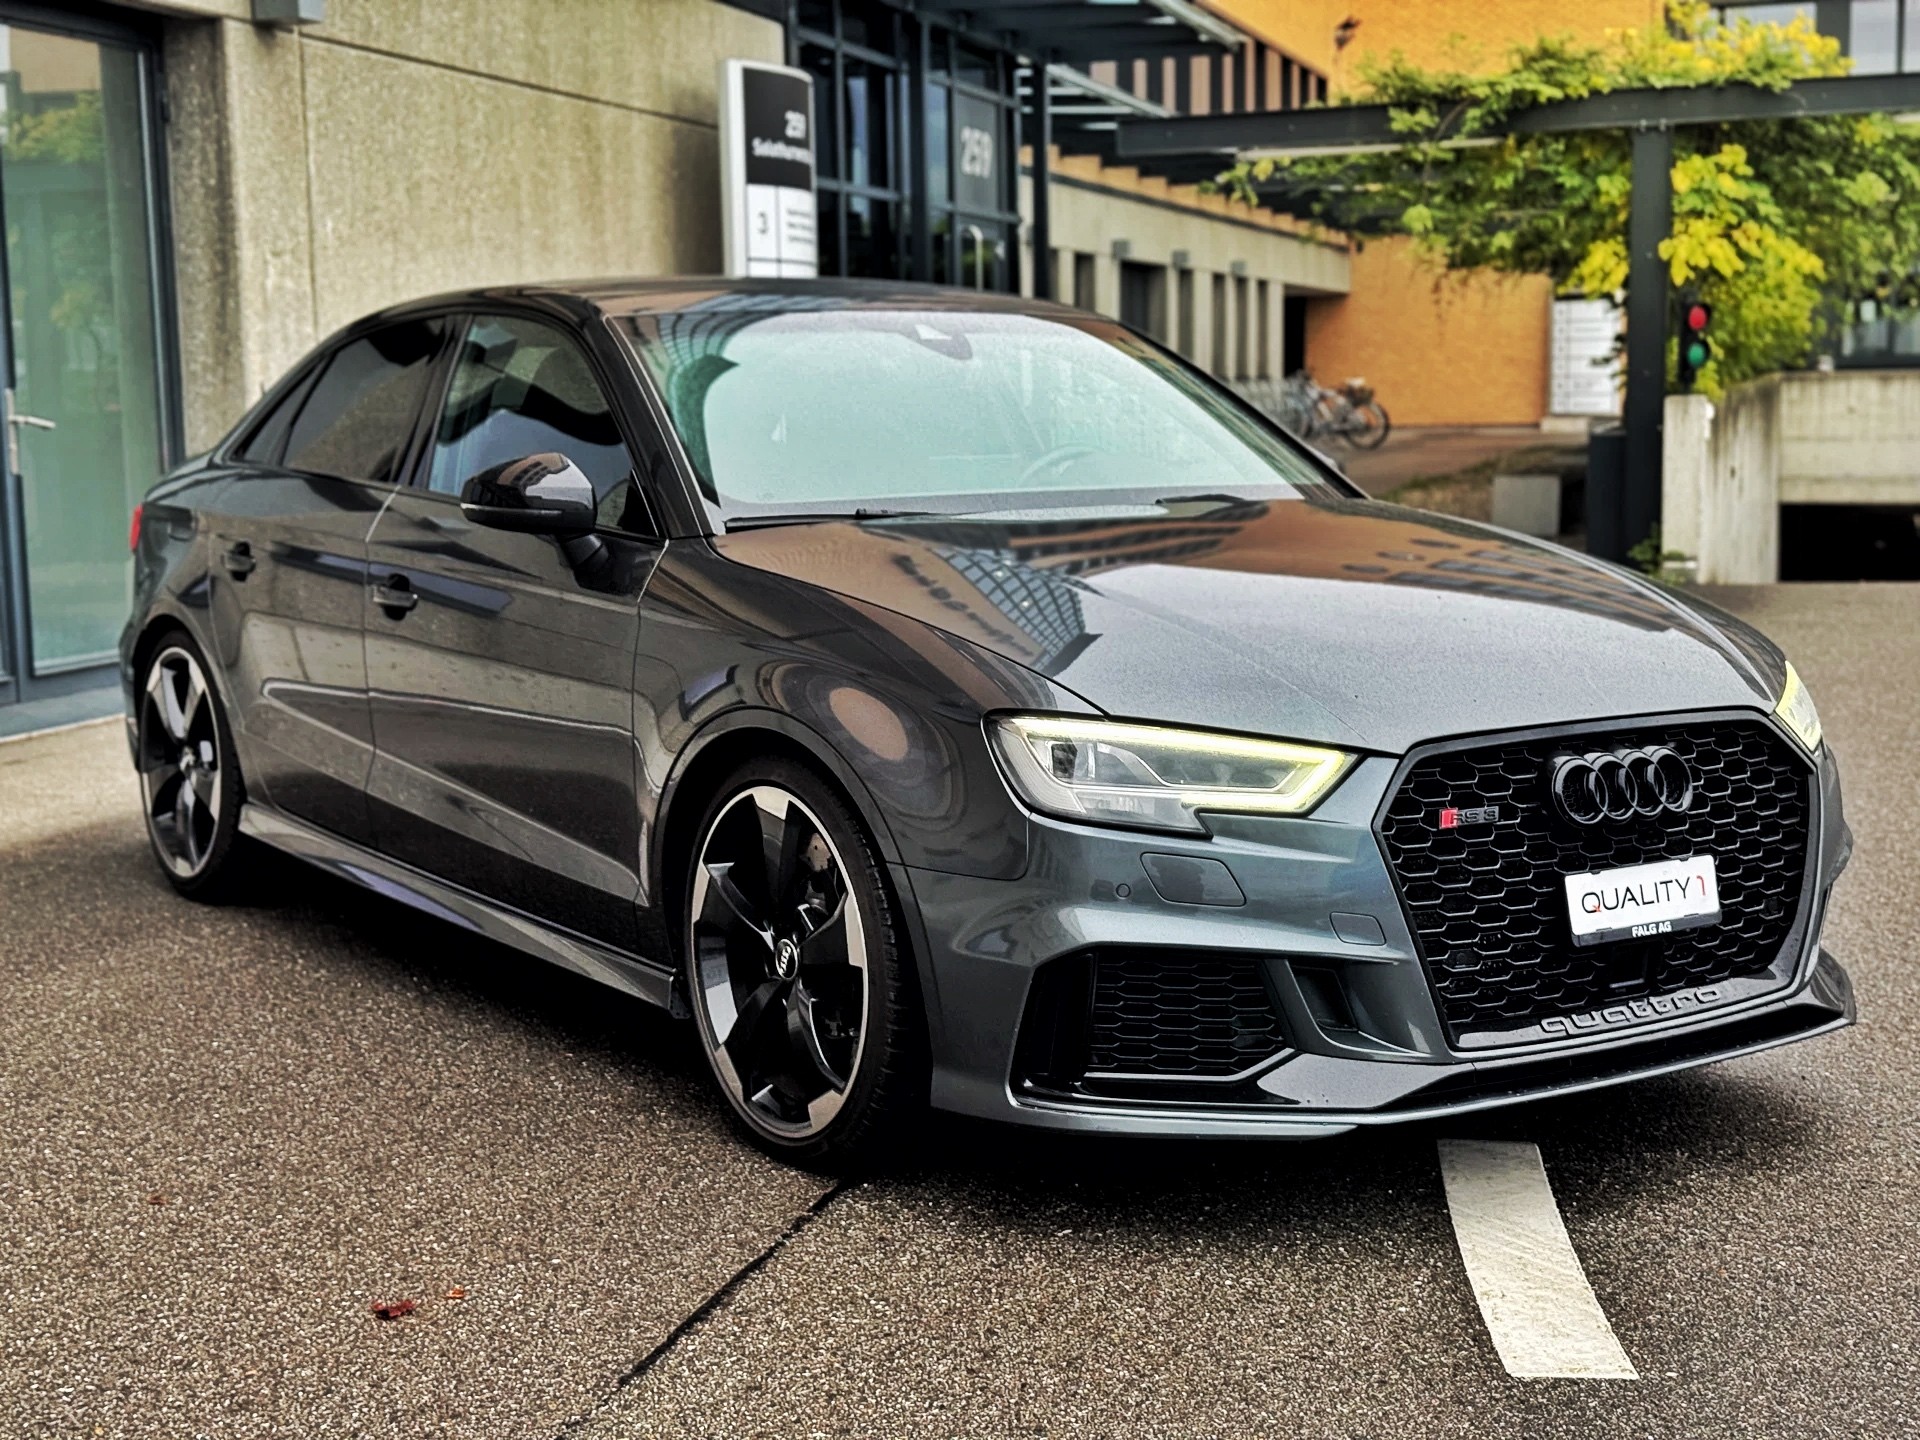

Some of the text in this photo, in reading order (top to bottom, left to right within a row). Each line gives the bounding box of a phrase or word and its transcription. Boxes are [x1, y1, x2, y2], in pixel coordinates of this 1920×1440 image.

[1581, 875, 1707, 914] QUALITY 1
[1631, 920, 1673, 938] FALG AG
[1539, 986, 1721, 1036] quattro
